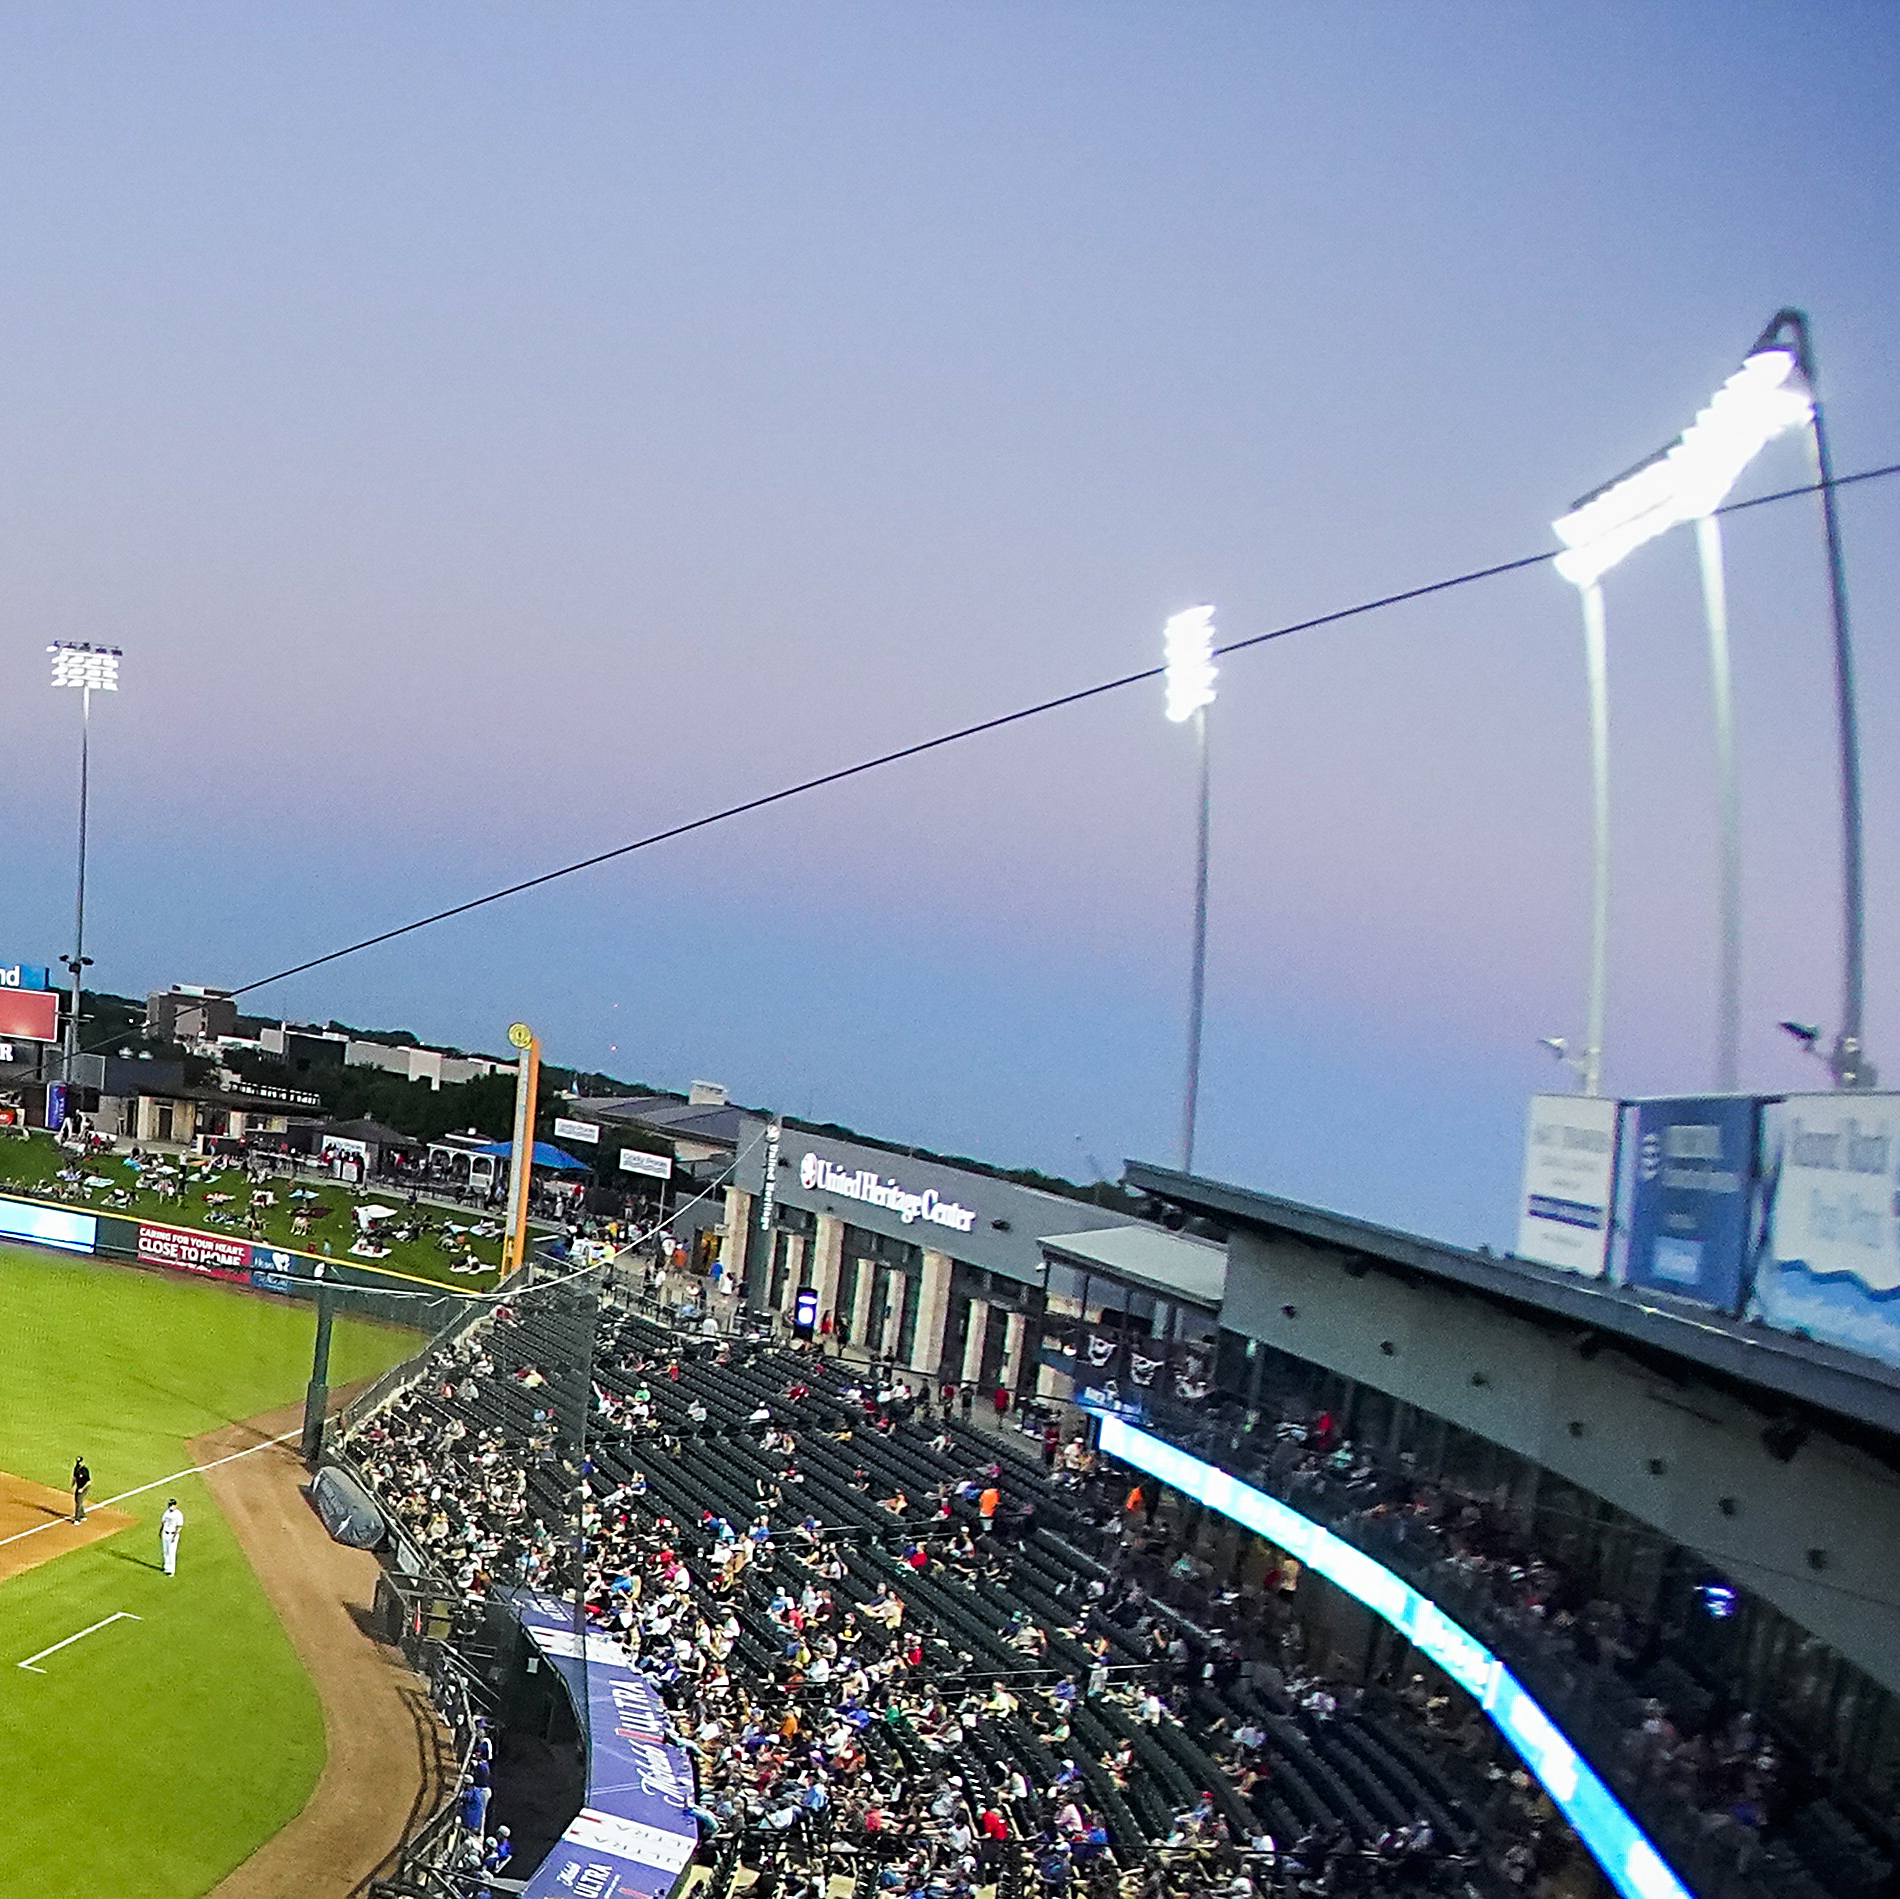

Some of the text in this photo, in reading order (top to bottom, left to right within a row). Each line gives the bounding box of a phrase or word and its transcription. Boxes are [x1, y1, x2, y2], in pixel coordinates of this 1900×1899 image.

[817, 1159, 977, 1233] United Heritage Center
[138, 1237, 179, 1258] CLOSE
[180, 1245, 200, 1262] TO
[200, 1250, 242, 1266] HOME
[139, 1227, 172, 1242] CARING
[172, 1234, 190, 1245] FOR
[191, 1237, 215, 1251] YOUR
[608, 1679, 663, 1733] ULTRA
[572, 1862, 613, 1899] ULTRA
